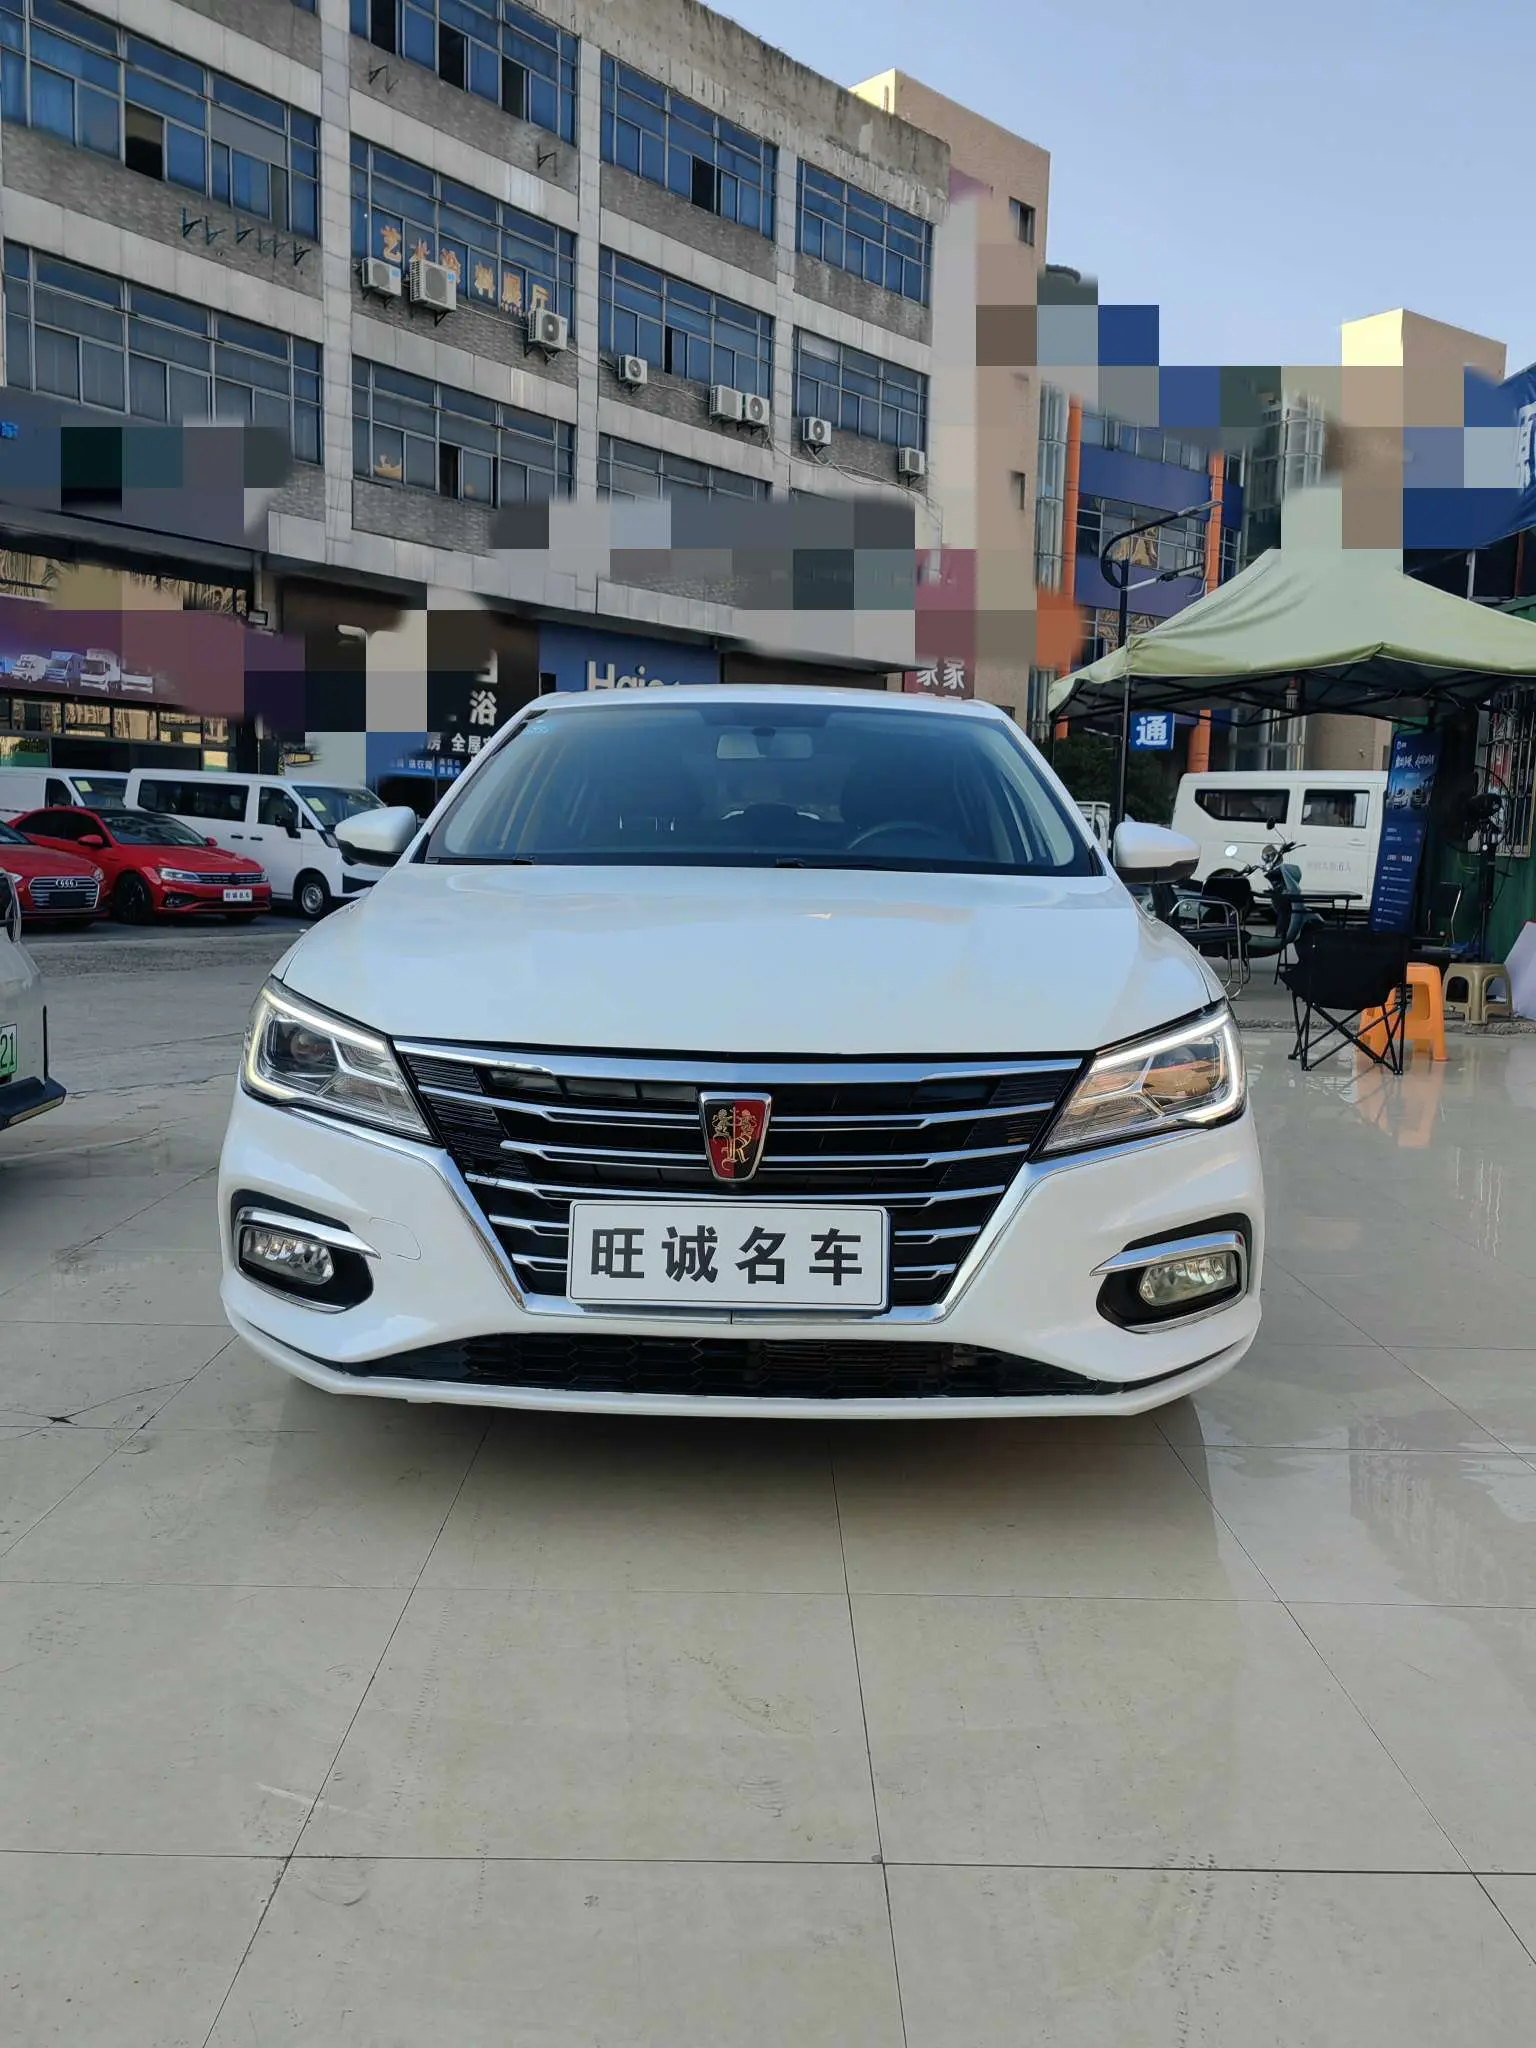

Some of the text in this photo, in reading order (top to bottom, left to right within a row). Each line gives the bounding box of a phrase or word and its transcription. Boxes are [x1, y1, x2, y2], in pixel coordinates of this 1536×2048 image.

[469, 690, 498, 727] 浴
[1136, 715, 1168, 746] 通
[591, 1224, 862, 1286] 旺诚名车
